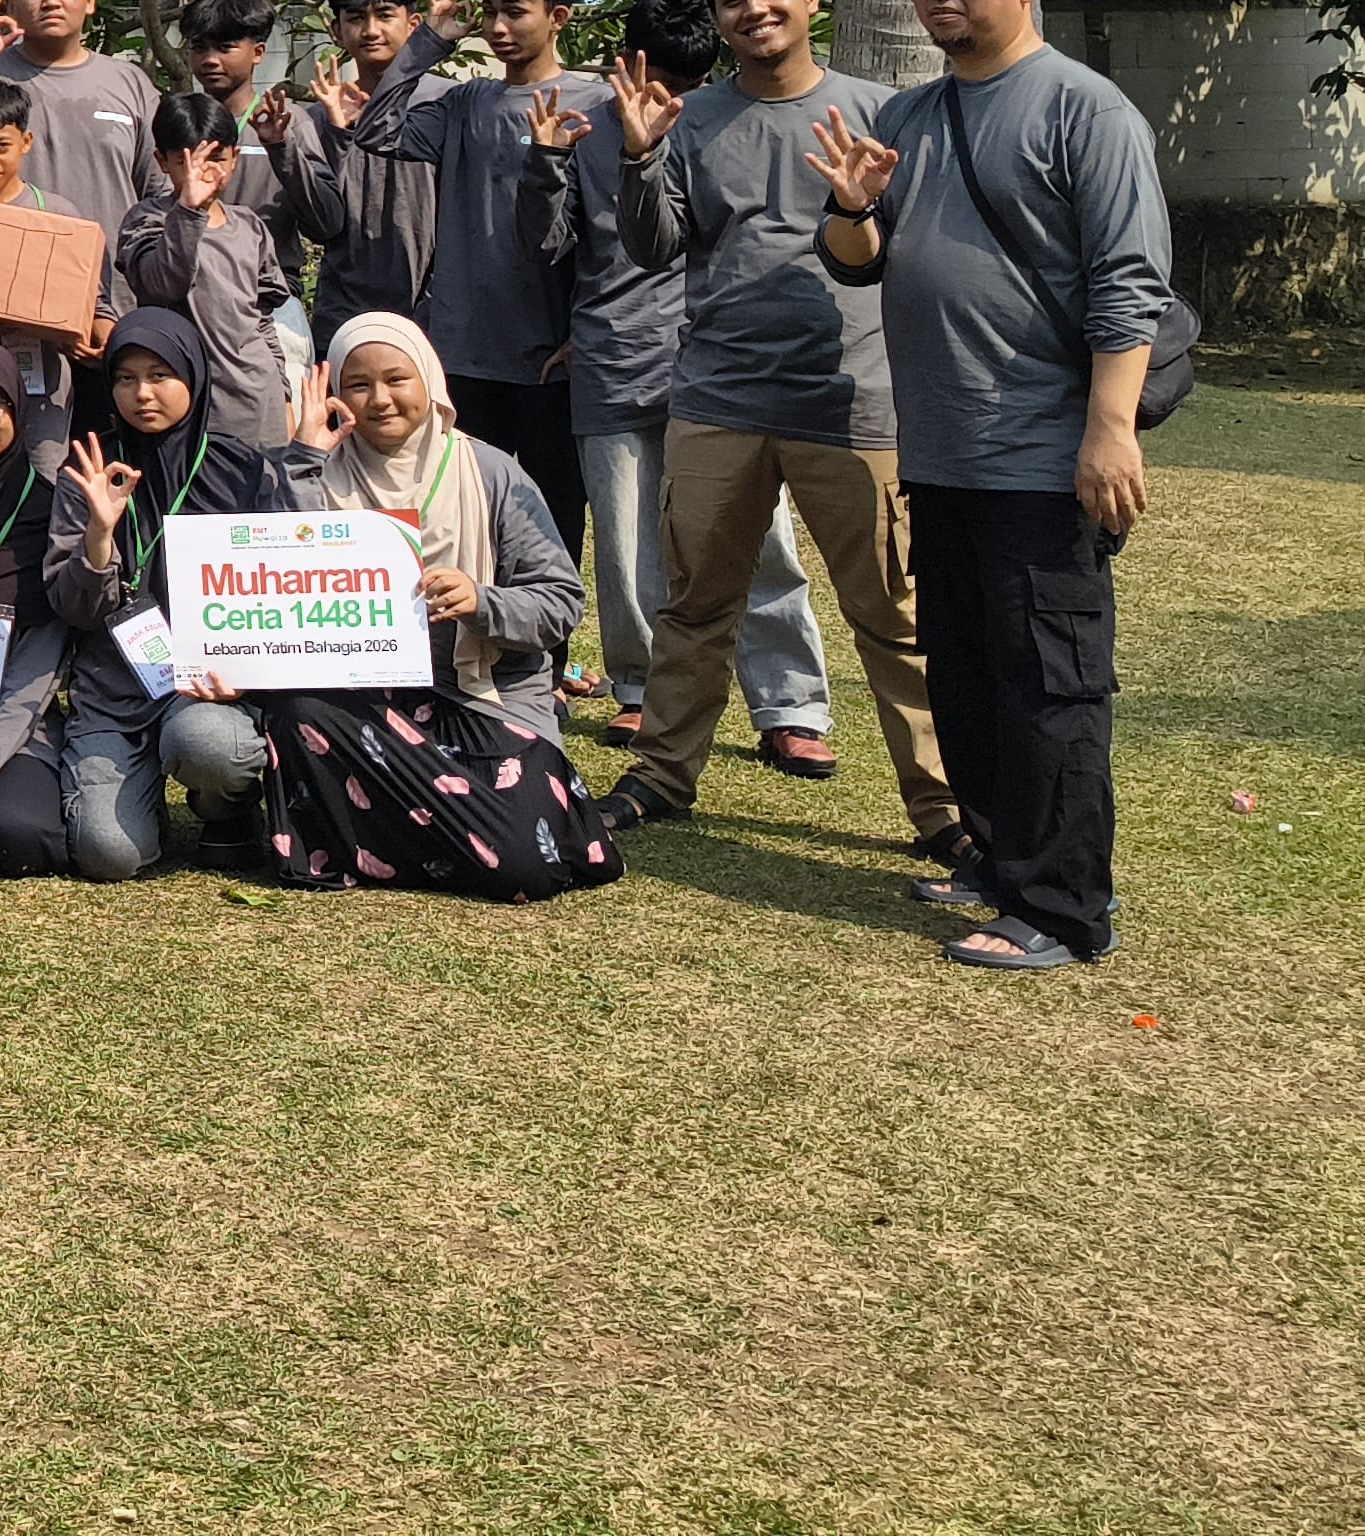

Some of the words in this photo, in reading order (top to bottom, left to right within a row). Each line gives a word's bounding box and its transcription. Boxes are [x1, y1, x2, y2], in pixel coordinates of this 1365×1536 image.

[321, 523, 350, 539] BSI
[201, 563, 390, 596] Muharram
[202, 602, 283, 631] Ceria
[289, 600, 362, 628] 1448
[370, 598, 394, 627] H
[203, 642, 260, 656] Lebaran
[262, 641, 301, 654] Yatim
[304, 640, 362, 656] Bahagia
[364, 639, 398, 653] 2026
